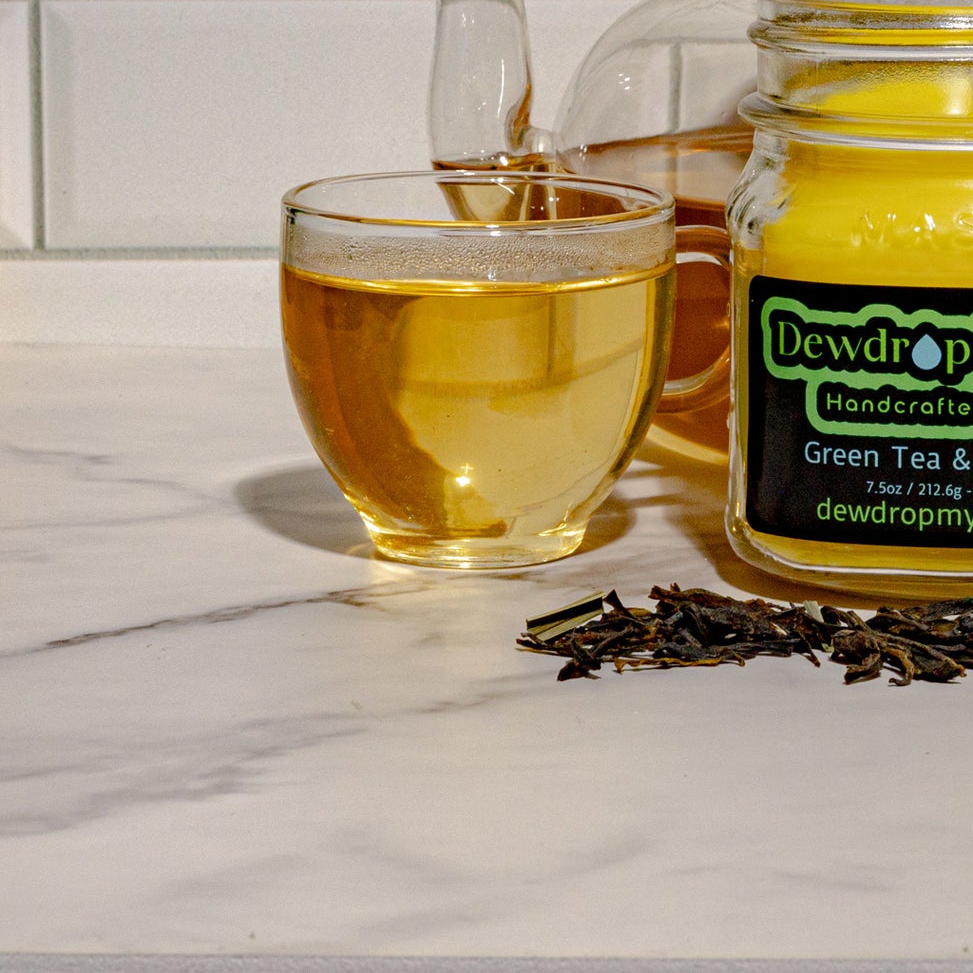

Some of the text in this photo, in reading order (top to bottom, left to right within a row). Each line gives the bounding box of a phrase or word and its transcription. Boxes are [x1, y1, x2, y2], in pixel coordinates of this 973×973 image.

[777, 321, 971, 374] Dewdrop
[804, 441, 879, 467] Green
[891, 445, 941, 470] Tea
[952, 447, 971, 470] &
[866, 480, 902, 495] 7.5oz
[906, 482, 914, 495] /
[918, 483, 962, 500] 212.6g
